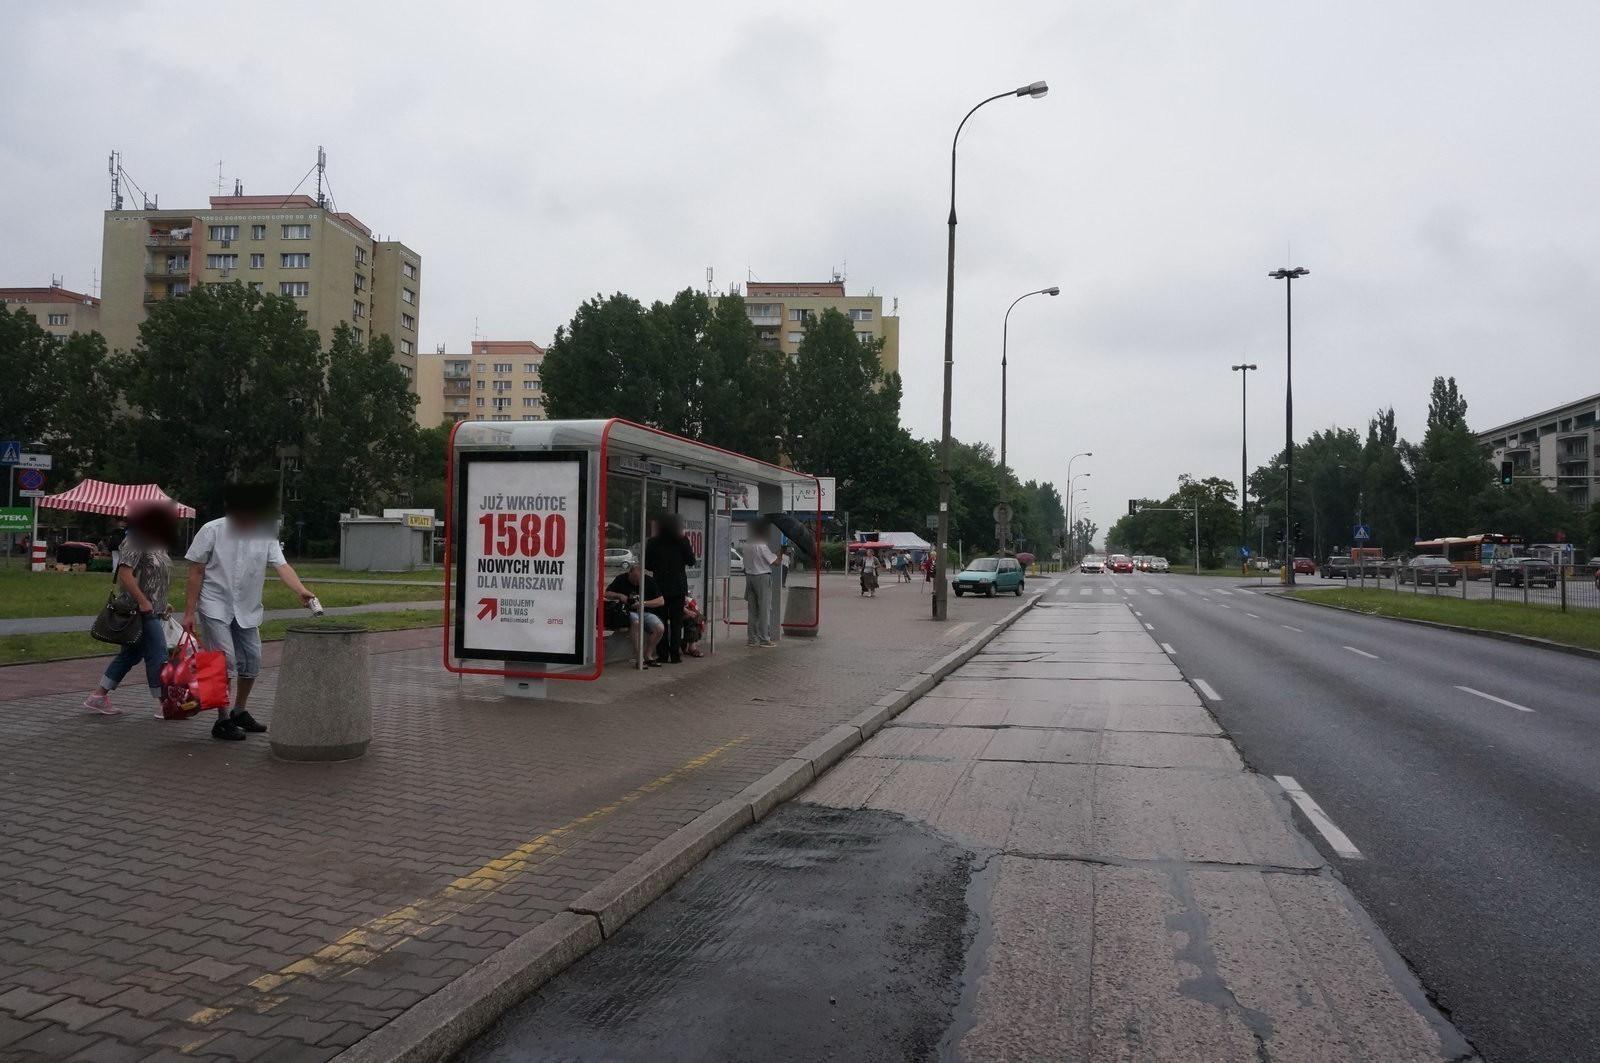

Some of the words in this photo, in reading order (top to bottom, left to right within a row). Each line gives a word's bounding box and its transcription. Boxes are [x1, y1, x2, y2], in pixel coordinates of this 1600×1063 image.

[480, 493, 504, 510] JUŻ
[507, 493, 567, 511] WKRÓTCE
[479, 513, 566, 558] 1580
[478, 558, 530, 574] NOWYCH
[534, 560, 564, 576] WIAT
[477, 575, 498, 589] DLA
[501, 577, 564, 591] WARSZAWY
[500, 598, 535, 607] BUDUJEMY
[500, 607, 512, 615] DLA
[513, 608, 528, 616] WAS
